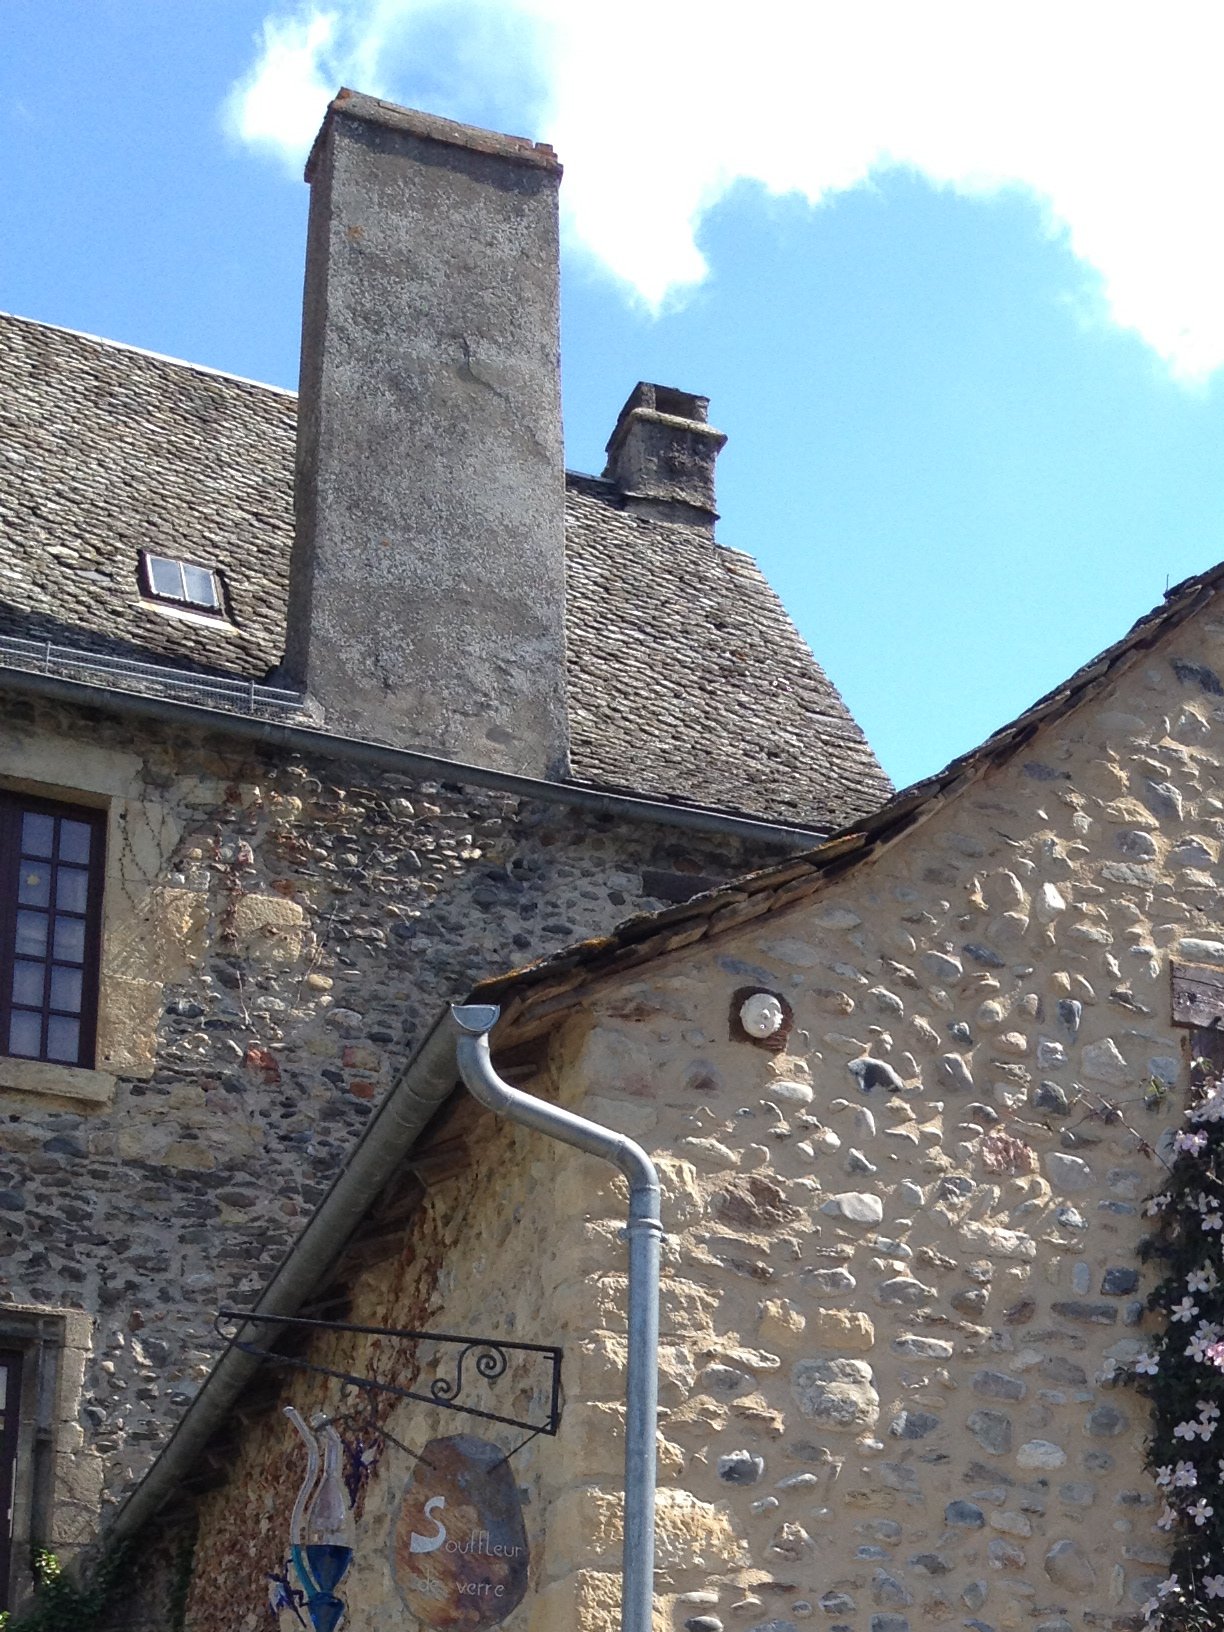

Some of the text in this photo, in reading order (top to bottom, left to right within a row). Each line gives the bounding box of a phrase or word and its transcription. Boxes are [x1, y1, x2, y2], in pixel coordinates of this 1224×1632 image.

[410, 1496, 522, 1558] Souffleur
[421, 1568, 505, 1597] de verre
